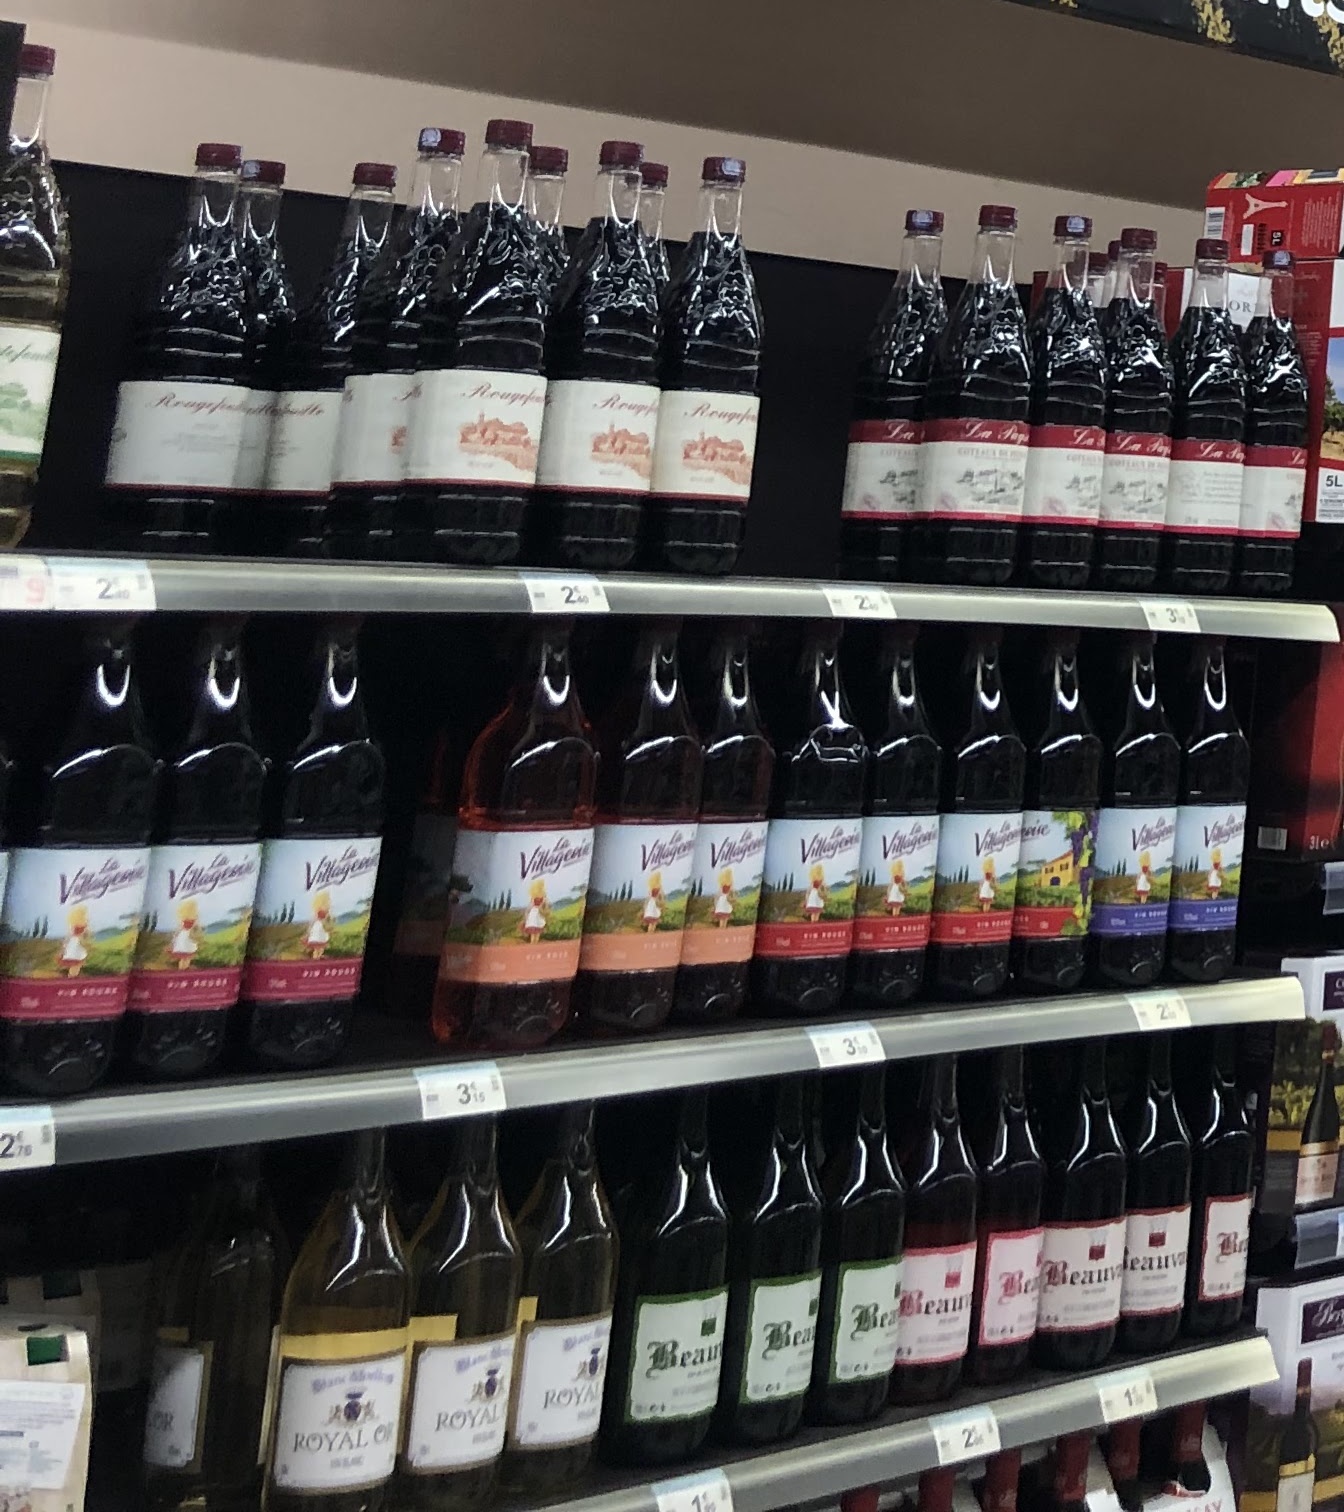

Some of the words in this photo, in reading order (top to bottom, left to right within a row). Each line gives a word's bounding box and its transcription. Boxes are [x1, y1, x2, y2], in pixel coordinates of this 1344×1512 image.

[1325, 475, 1343, 487] 5L
[435, 1402, 500, 1433] ROYAL
[293, 1429, 369, 1453] ROYAL
